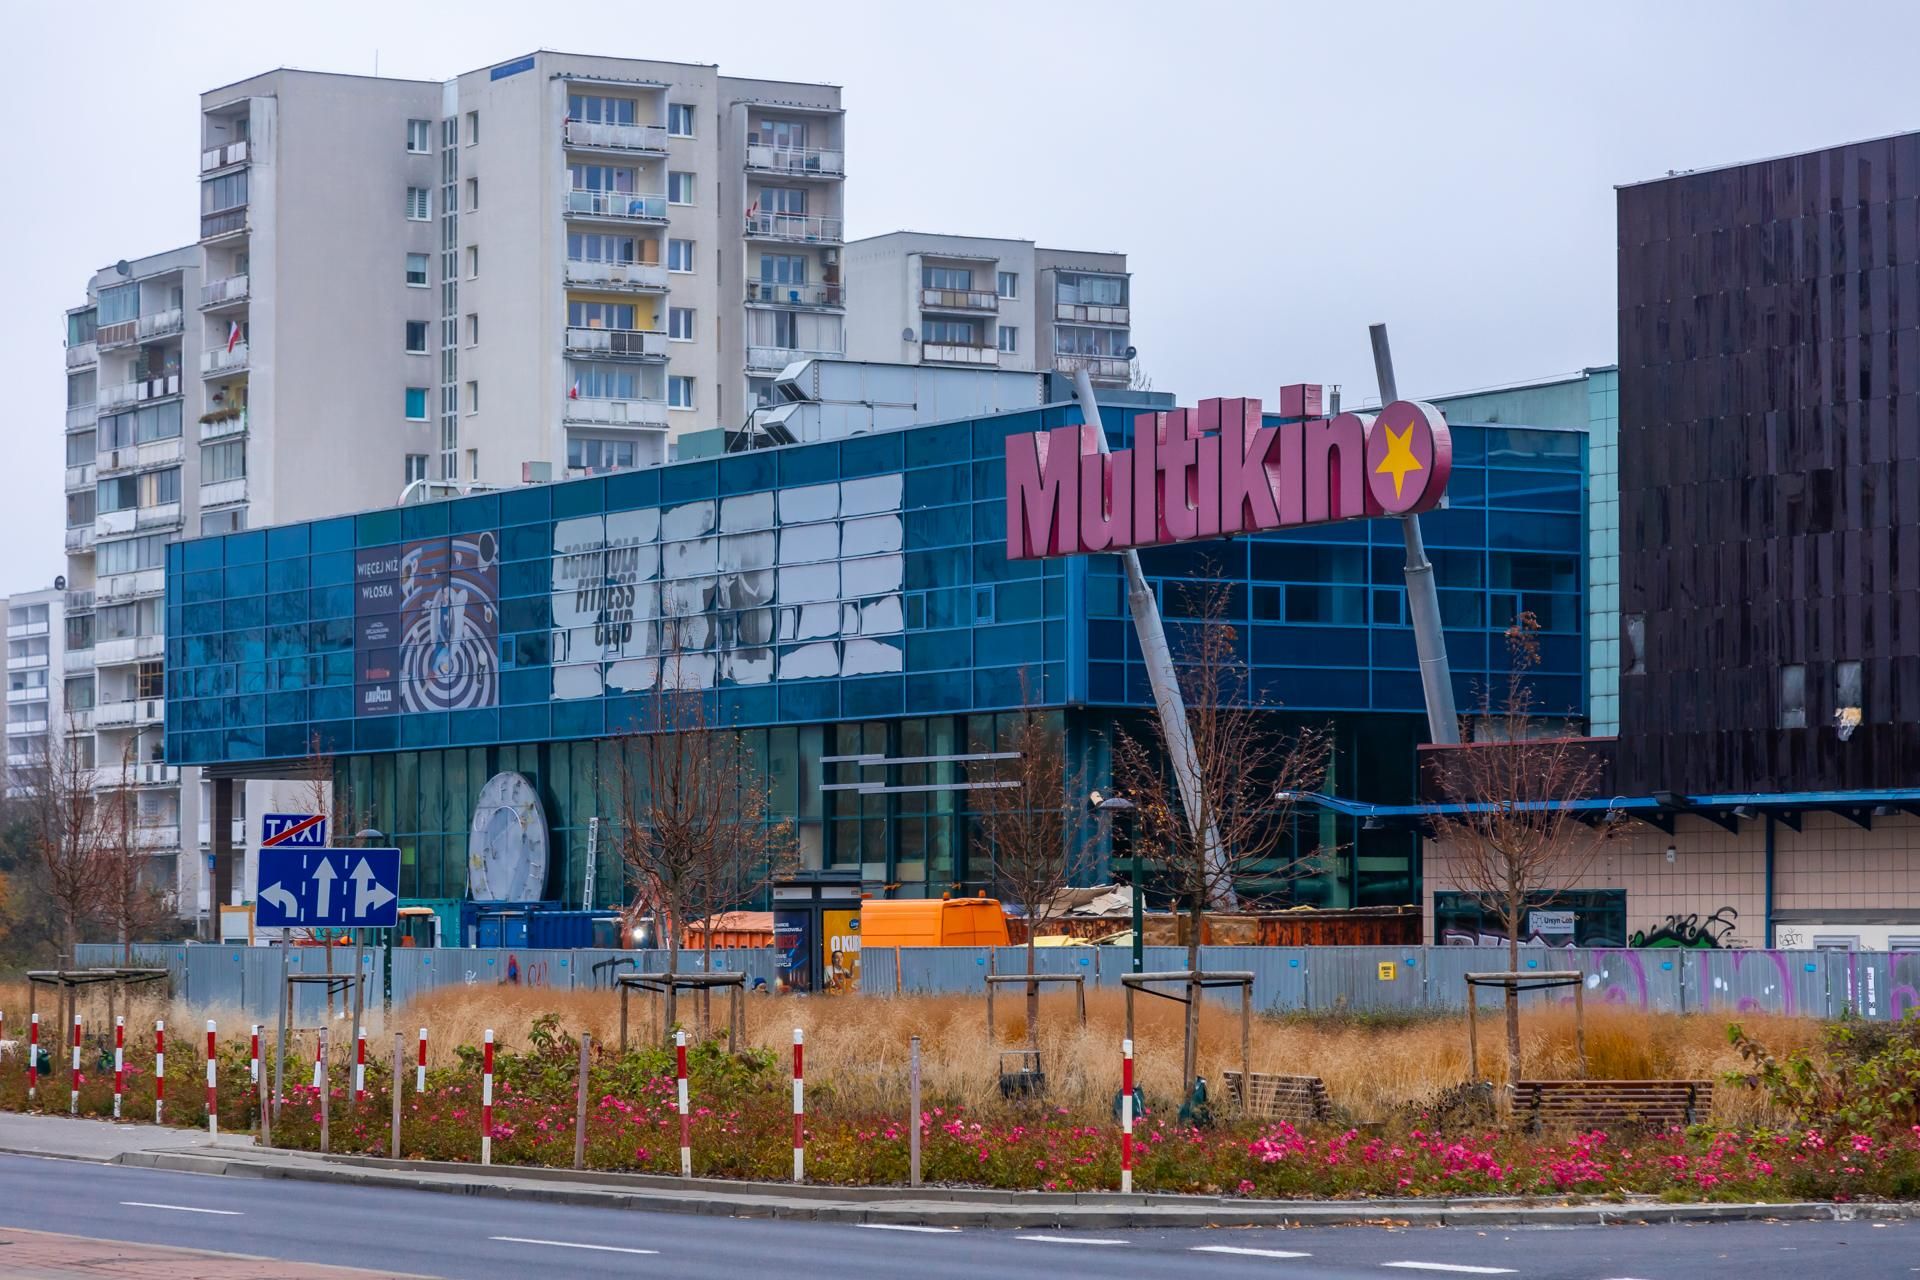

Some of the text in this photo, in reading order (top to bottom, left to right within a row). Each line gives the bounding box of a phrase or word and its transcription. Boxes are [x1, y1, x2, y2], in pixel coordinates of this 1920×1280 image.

[1005, 384, 1452, 560] Multikino
[357, 556, 398, 578] WIĘCEJ NIŻ
[362, 585, 393, 599] WŁOSKA
[575, 571, 637, 614] FITNESS
[594, 608, 634, 647] CLUB
[266, 820, 322, 842] TAXI
[1544, 917, 1560, 925] Ursyn
